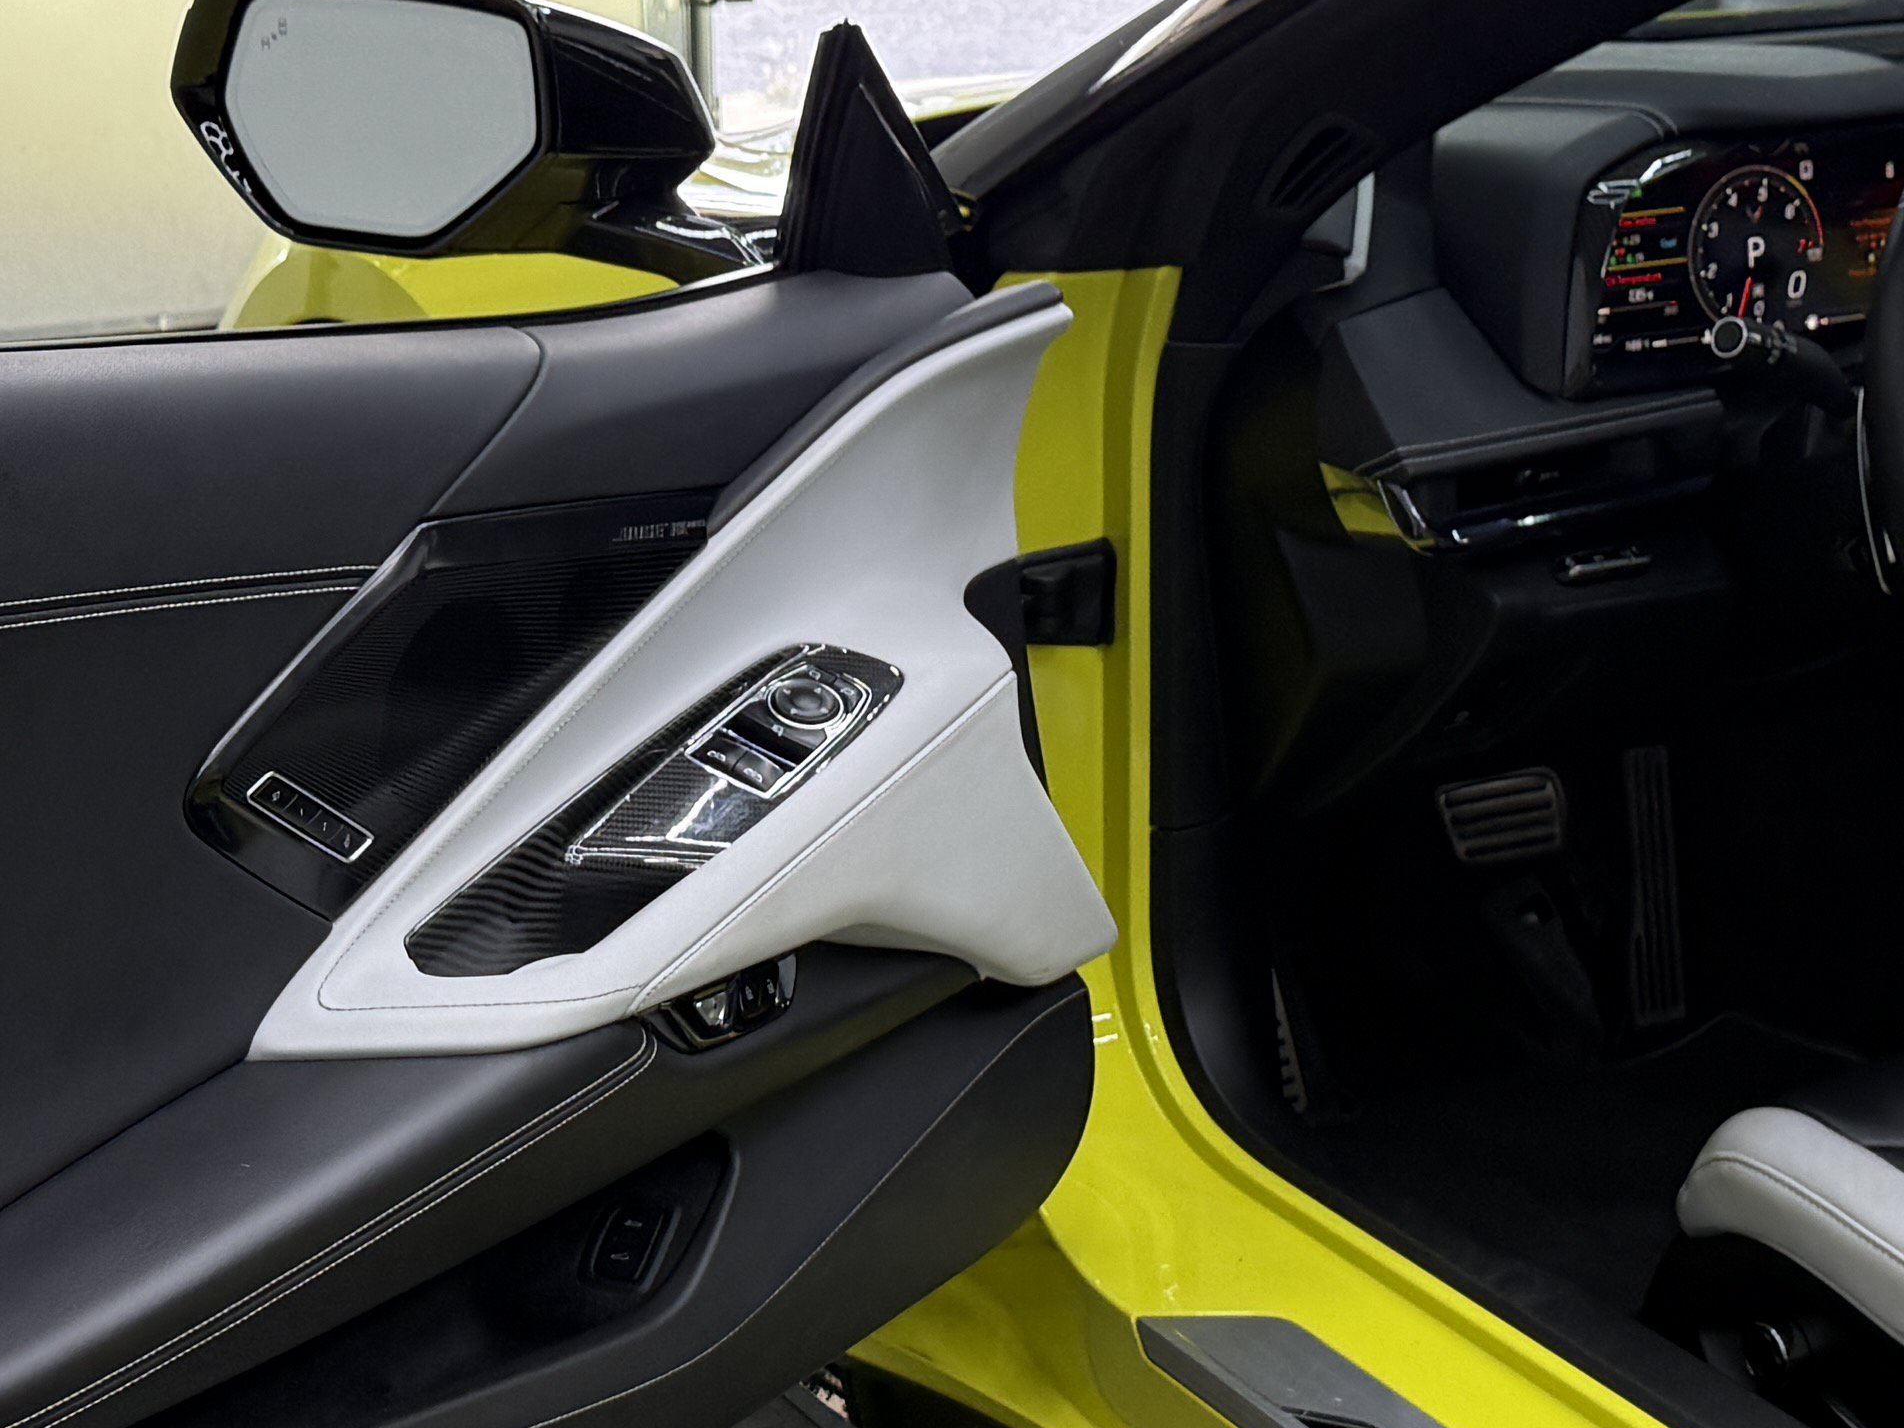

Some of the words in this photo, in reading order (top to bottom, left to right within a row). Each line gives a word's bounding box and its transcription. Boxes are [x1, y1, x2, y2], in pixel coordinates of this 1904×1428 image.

[1708, 221, 1719, 238] 3
[1747, 236, 1765, 268] P
[1788, 270, 1807, 298] 0
